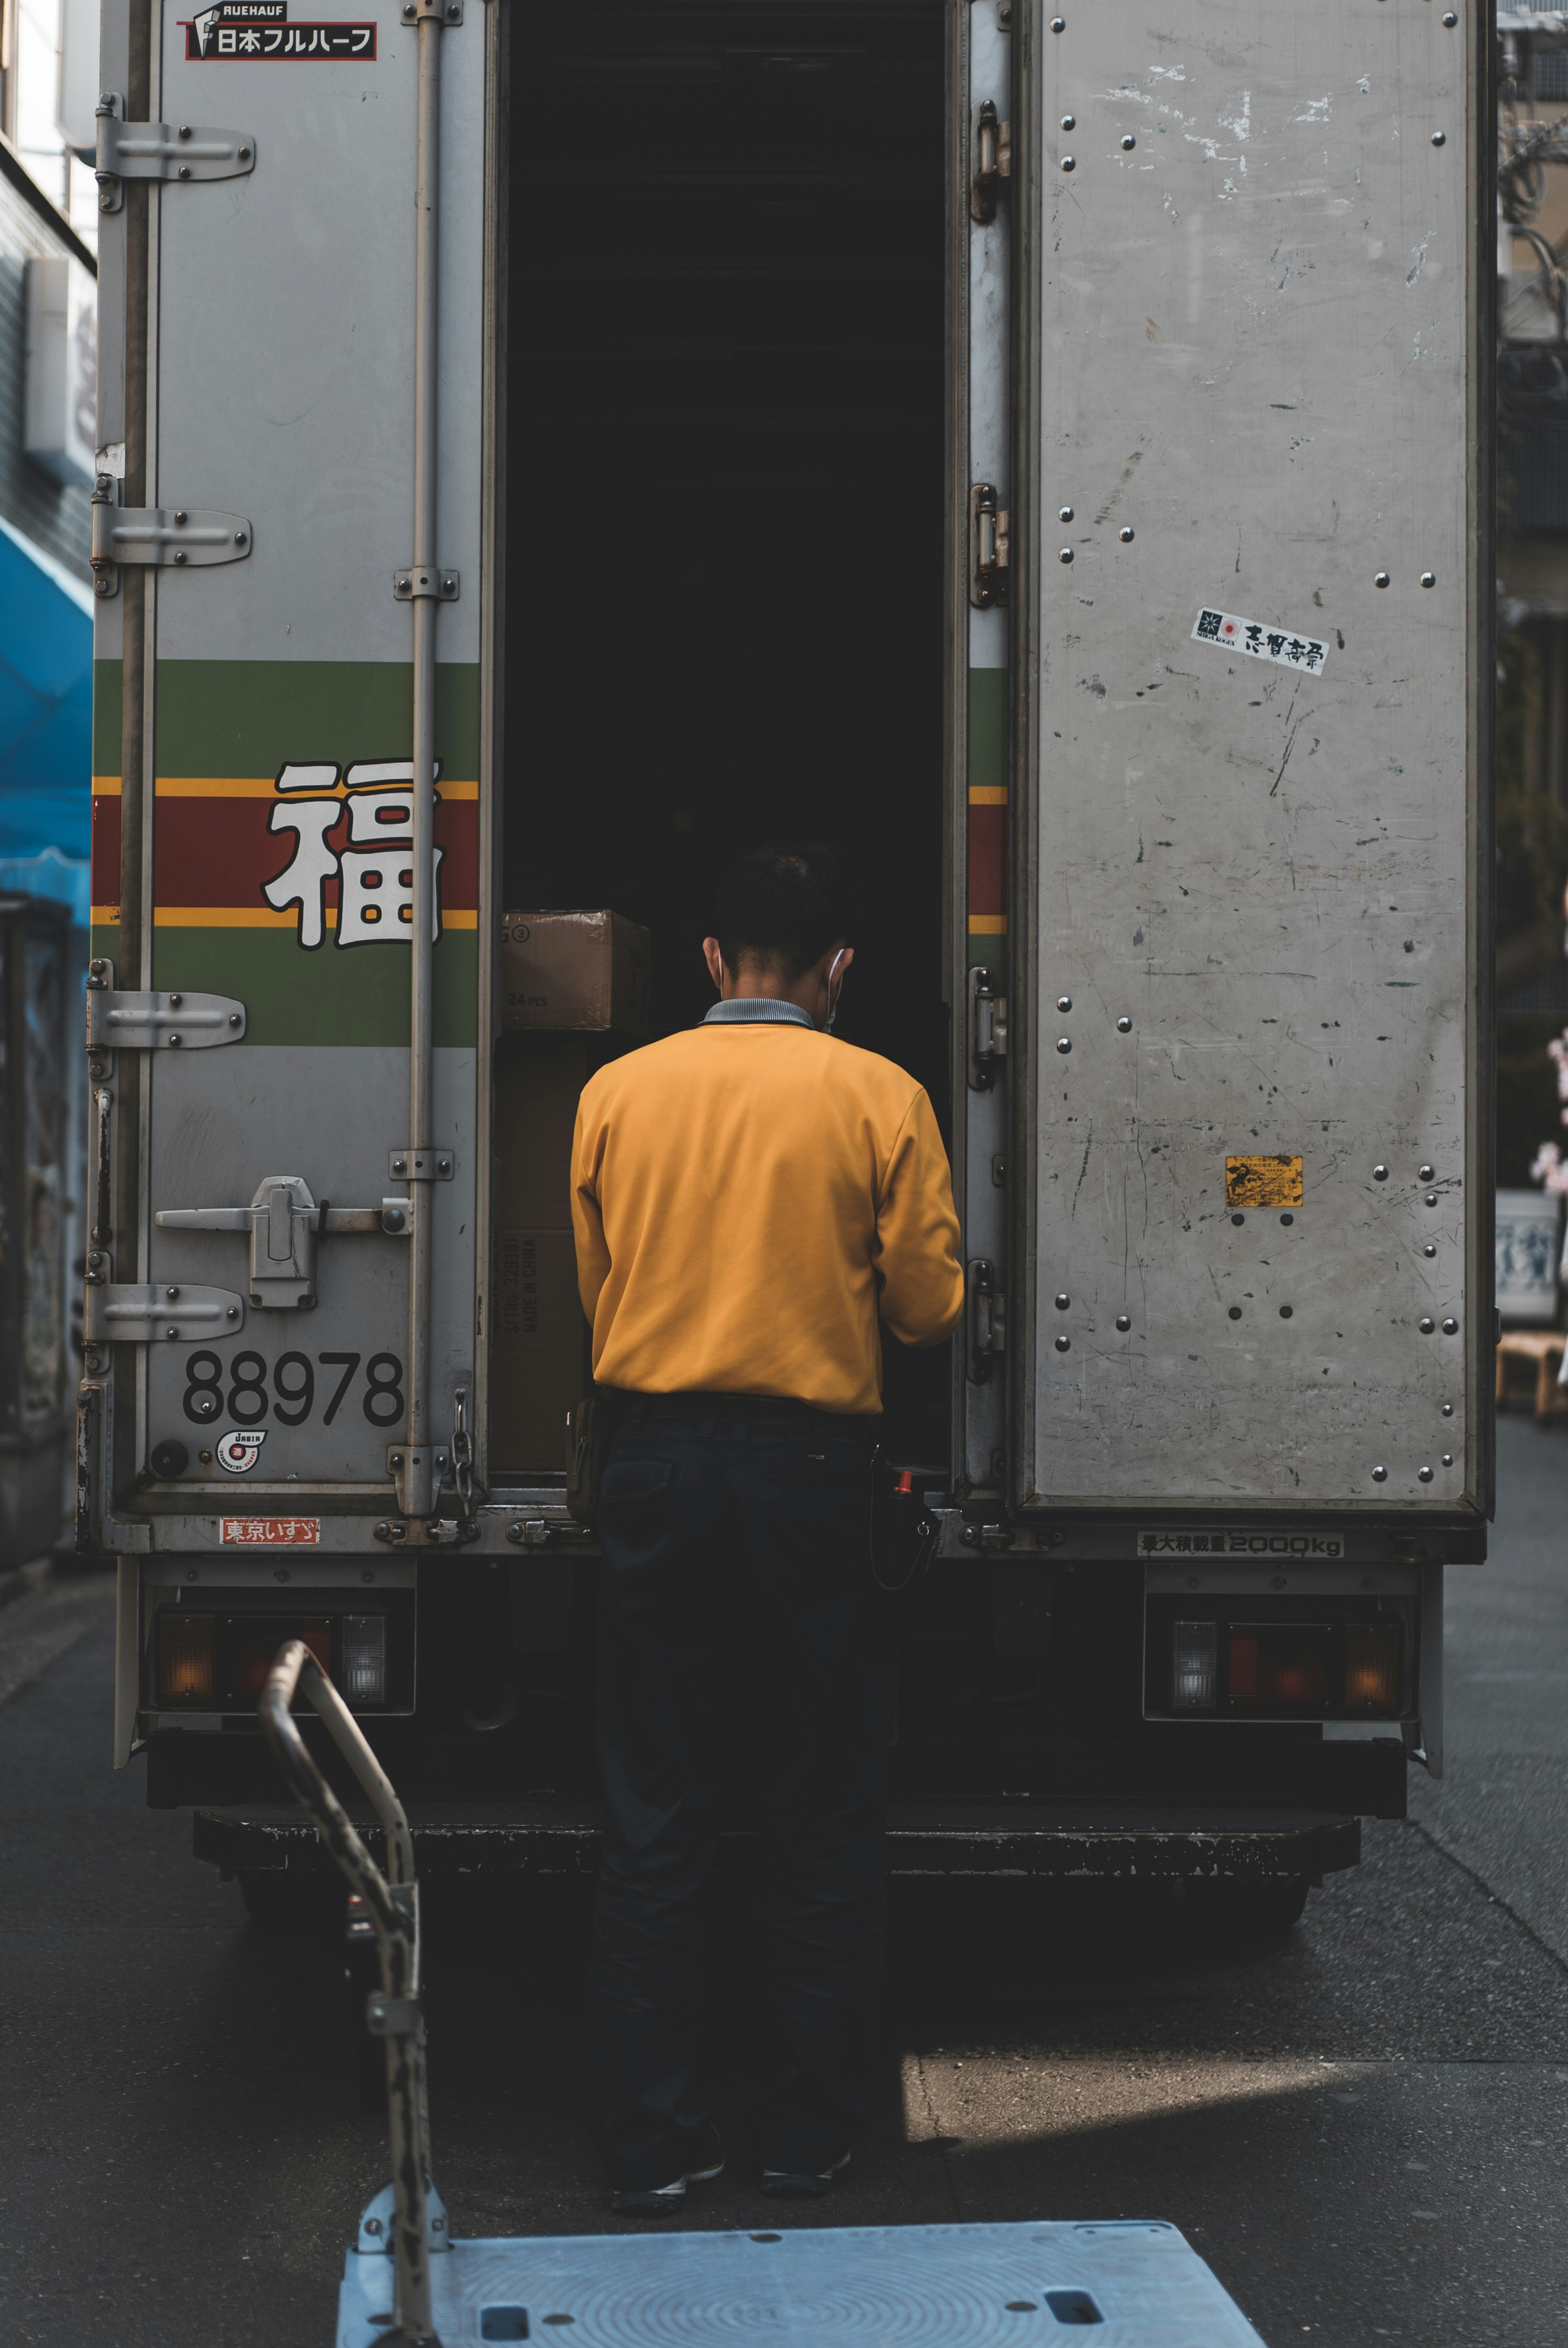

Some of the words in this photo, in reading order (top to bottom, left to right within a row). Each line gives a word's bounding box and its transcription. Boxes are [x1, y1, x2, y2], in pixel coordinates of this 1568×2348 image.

[218, 29, 371, 53] 日本フルハーフ
[1196, 631, 1214, 641] SHIGA
[1215, 636, 1235, 646] KOGEN
[1245, 625, 1324, 669] 志賀高原
[259, 757, 448, 952] 福
[508, 993, 525, 1006] 24
[528, 996, 548, 1007] PCS
[503, 1238, 519, 1286] 329381
[522, 1239, 537, 1278] CHINA
[523, 1282, 537, 1294] IN
[523, 1297, 537, 1333] MADE
[183, 1350, 405, 1428] 88978
[235, 1433, 261, 1442] JABIA
